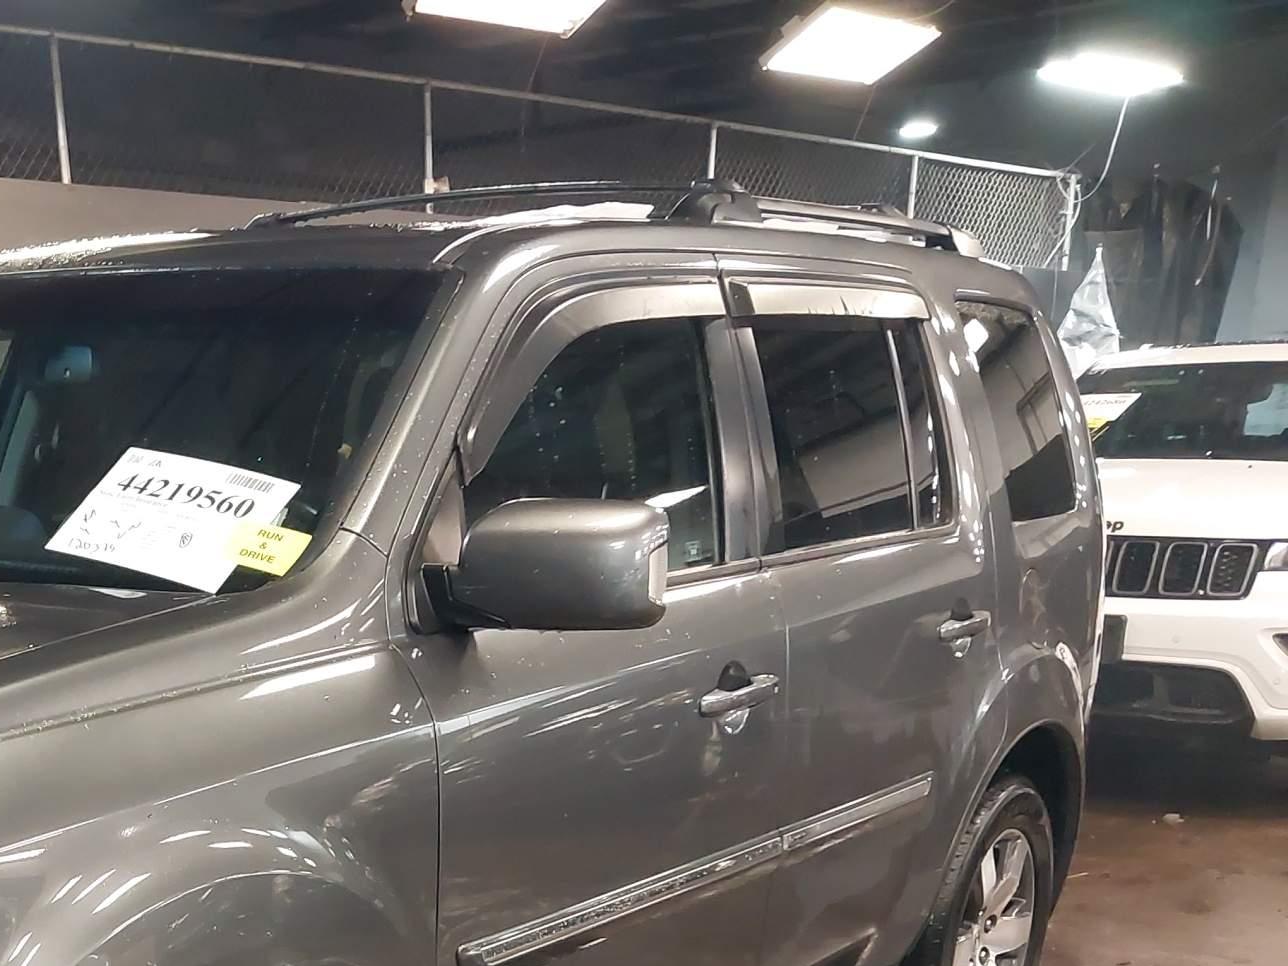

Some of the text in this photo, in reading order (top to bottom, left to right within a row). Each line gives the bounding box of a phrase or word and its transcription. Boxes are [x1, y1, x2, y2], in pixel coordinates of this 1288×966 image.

[117, 474, 255, 518] 44219560
[257, 528, 284, 543] RUN
[258, 542, 269, 550] &
[239, 548, 277, 565] DRIVE
